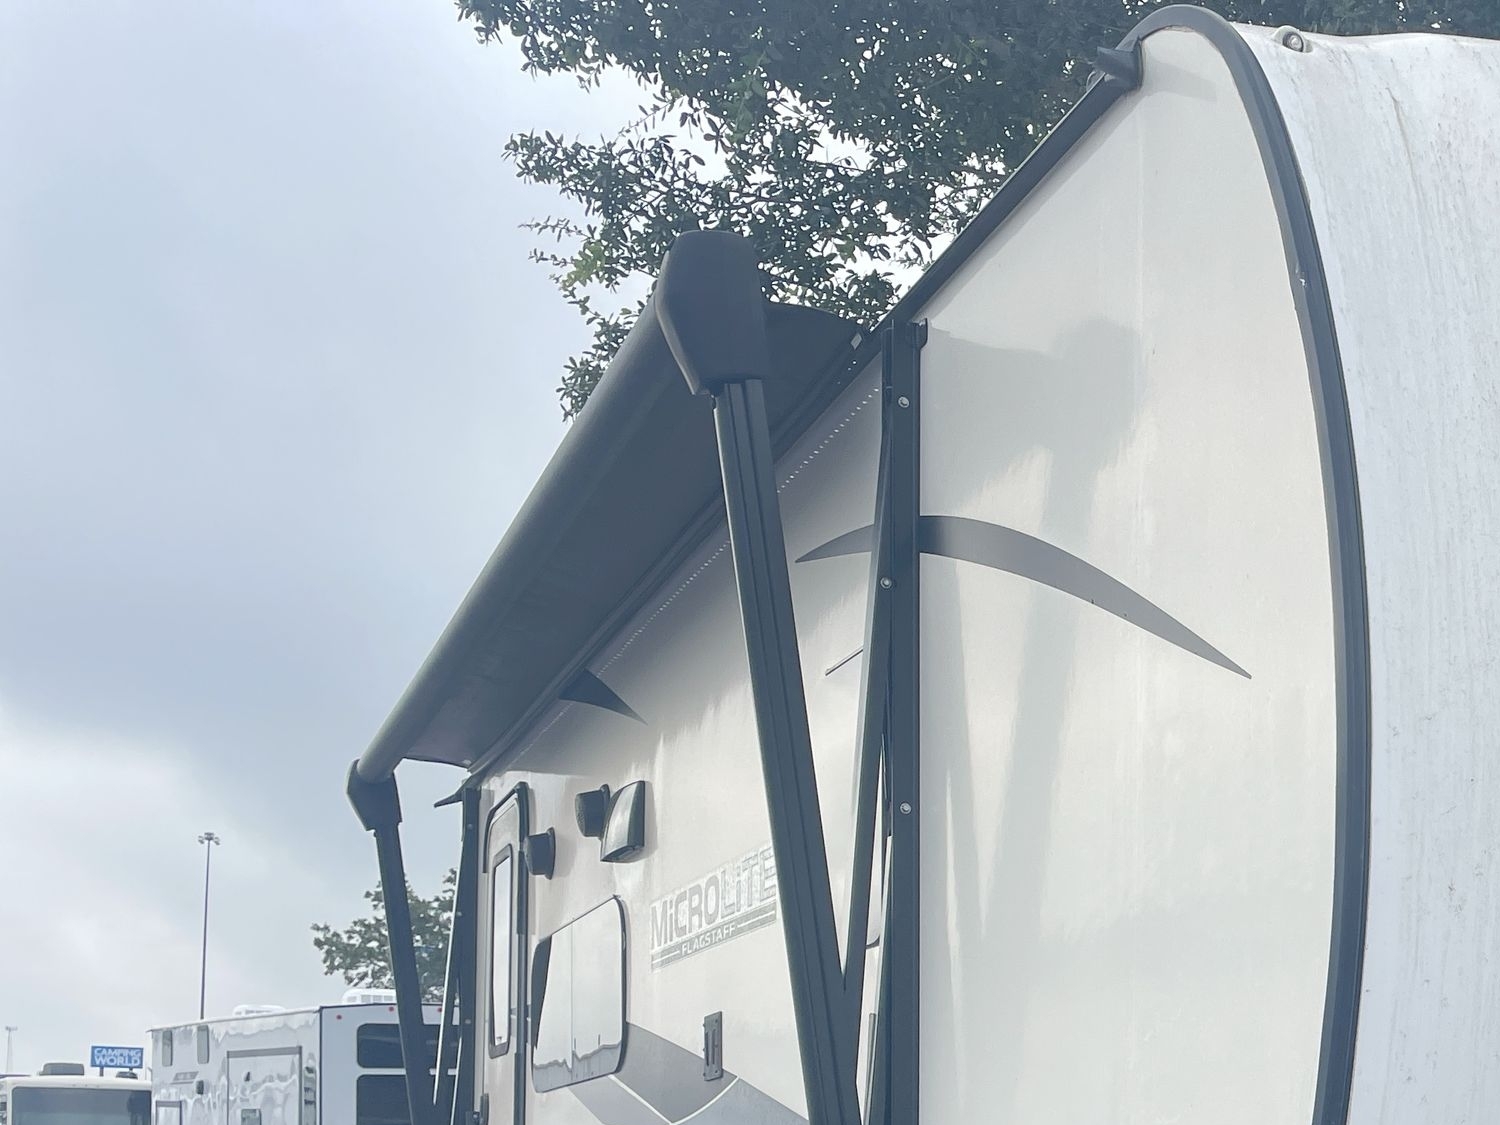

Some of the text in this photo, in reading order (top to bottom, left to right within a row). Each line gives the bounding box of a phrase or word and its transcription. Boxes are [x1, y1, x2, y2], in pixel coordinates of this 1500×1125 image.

[681, 922, 737, 956] FLAGSTAFF
[94, 1047, 142, 1057] CAMPING
[94, 1055, 141, 1067] WORLD
